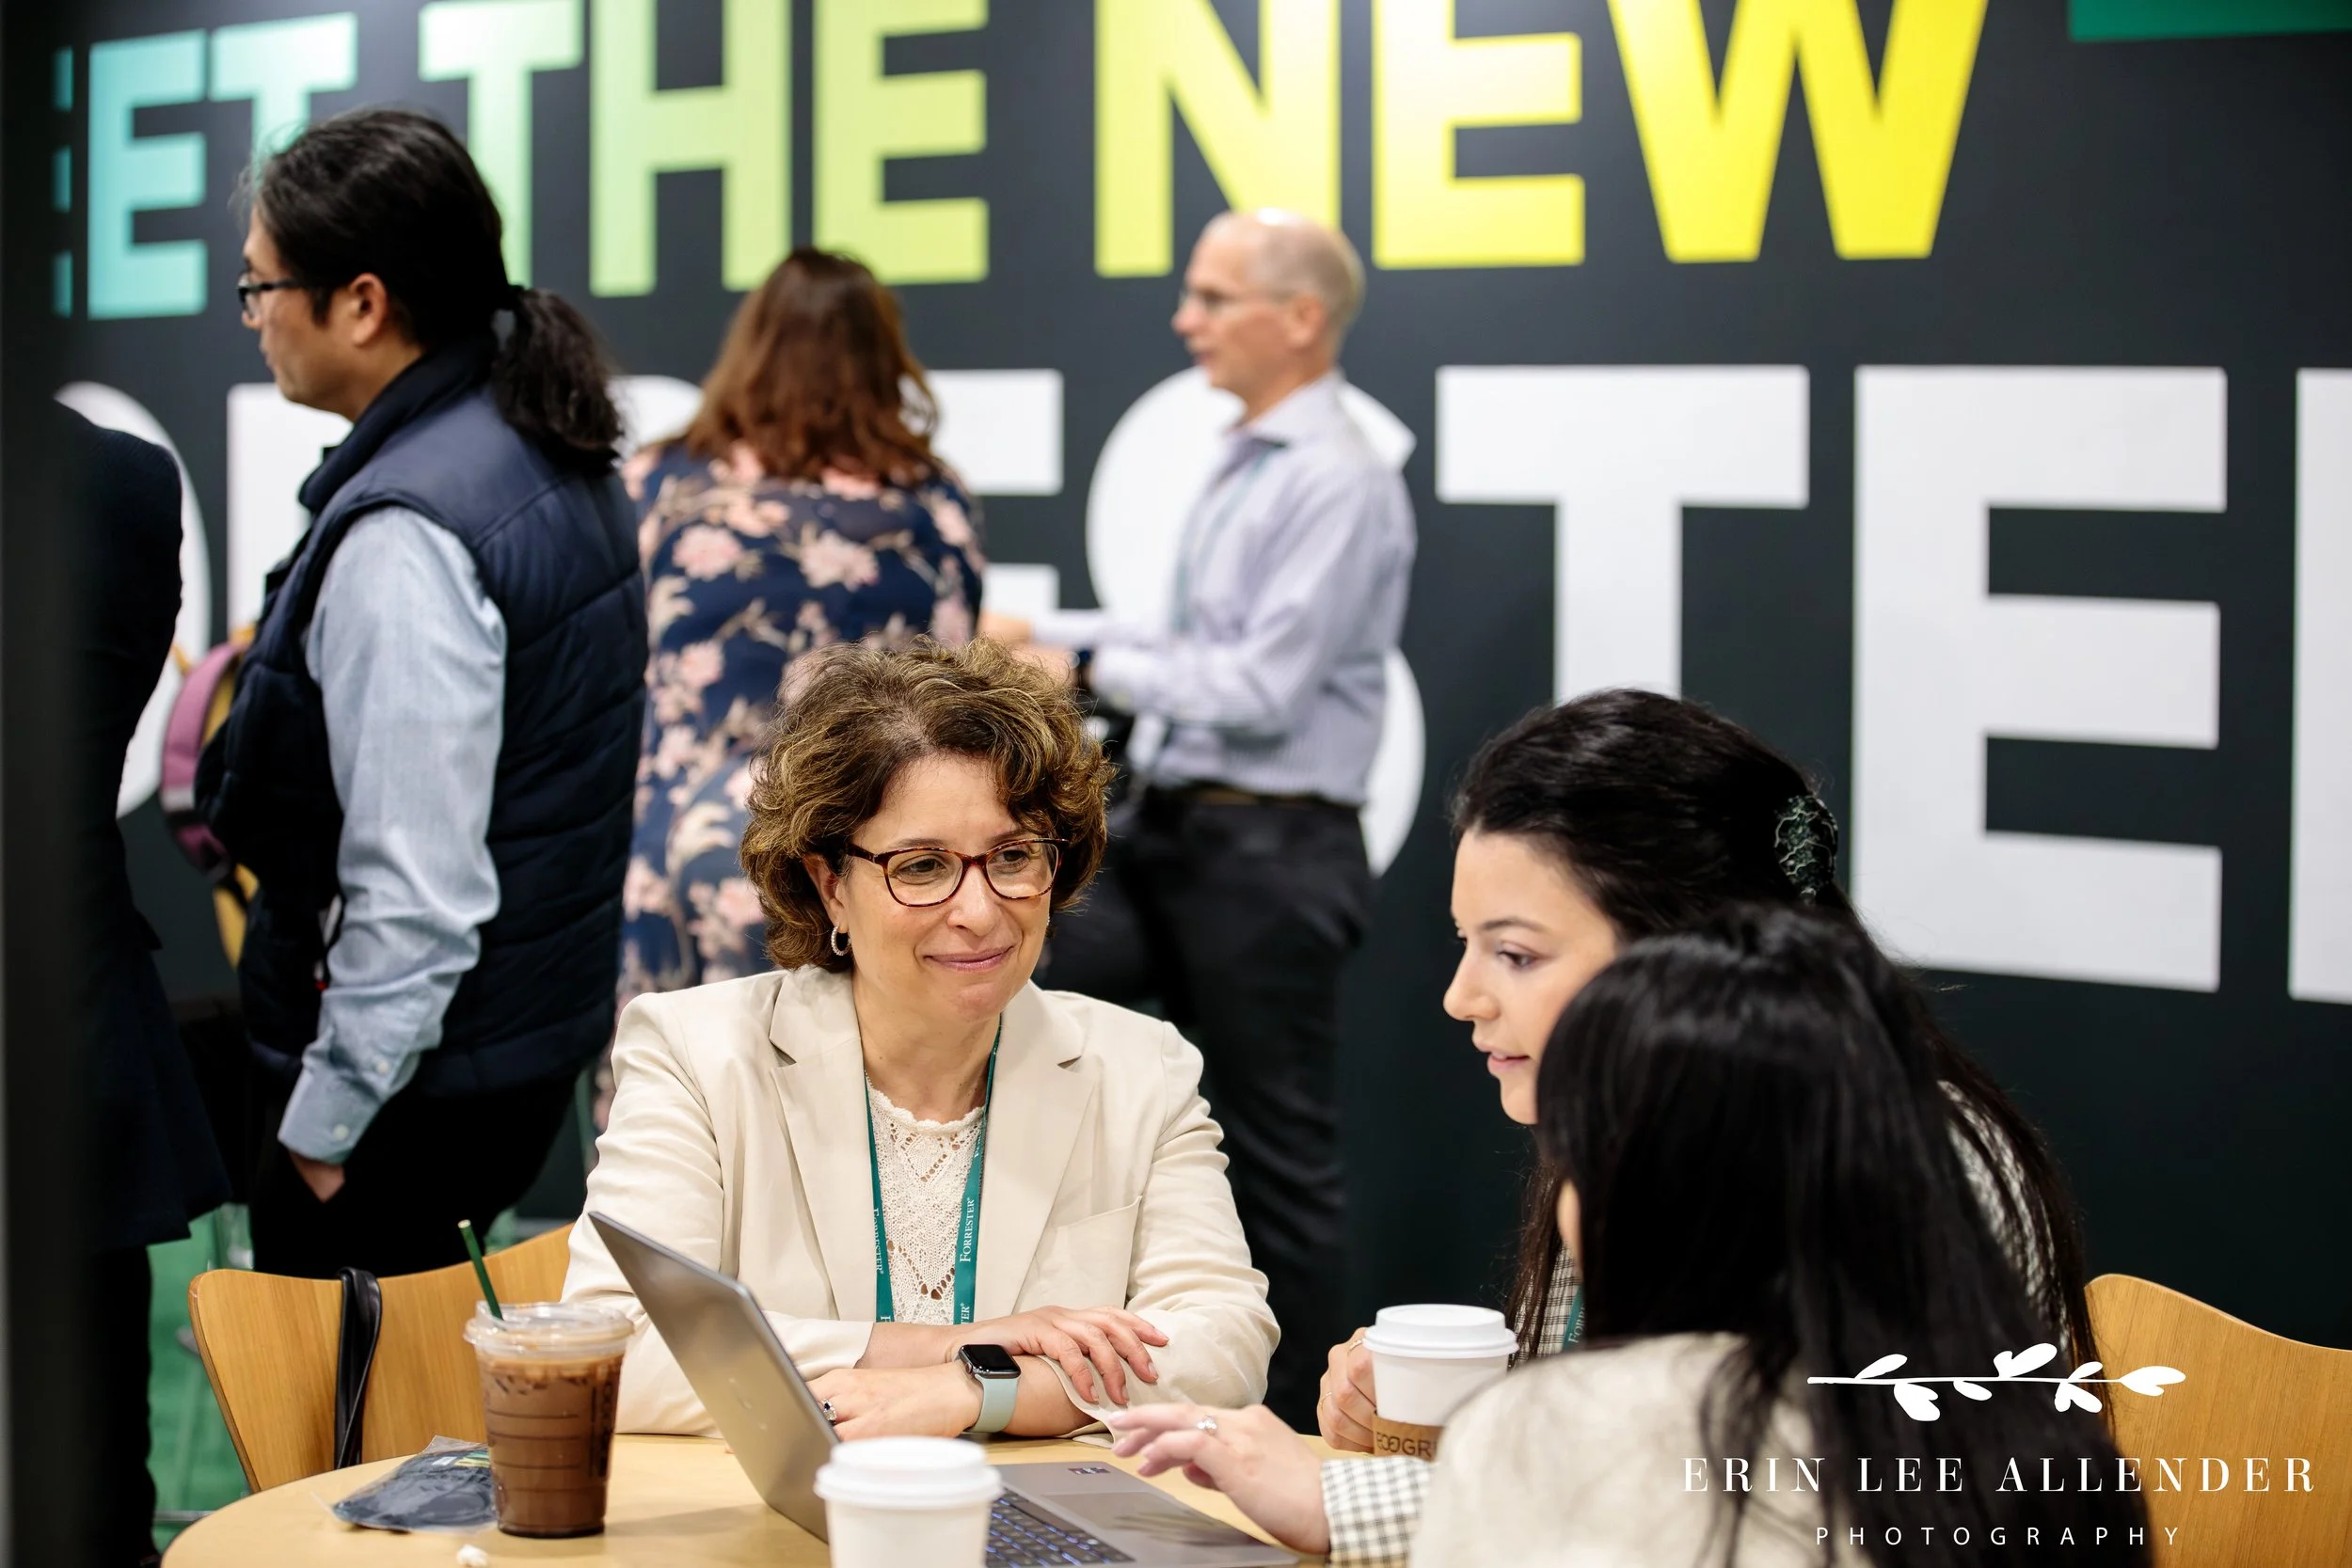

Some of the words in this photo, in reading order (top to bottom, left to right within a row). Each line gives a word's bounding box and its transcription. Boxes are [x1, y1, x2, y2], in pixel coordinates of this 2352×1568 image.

[53, 13, 358, 319] ET
[419, 0, 989, 295] THE
[1093, 0, 1989, 277] NEW
